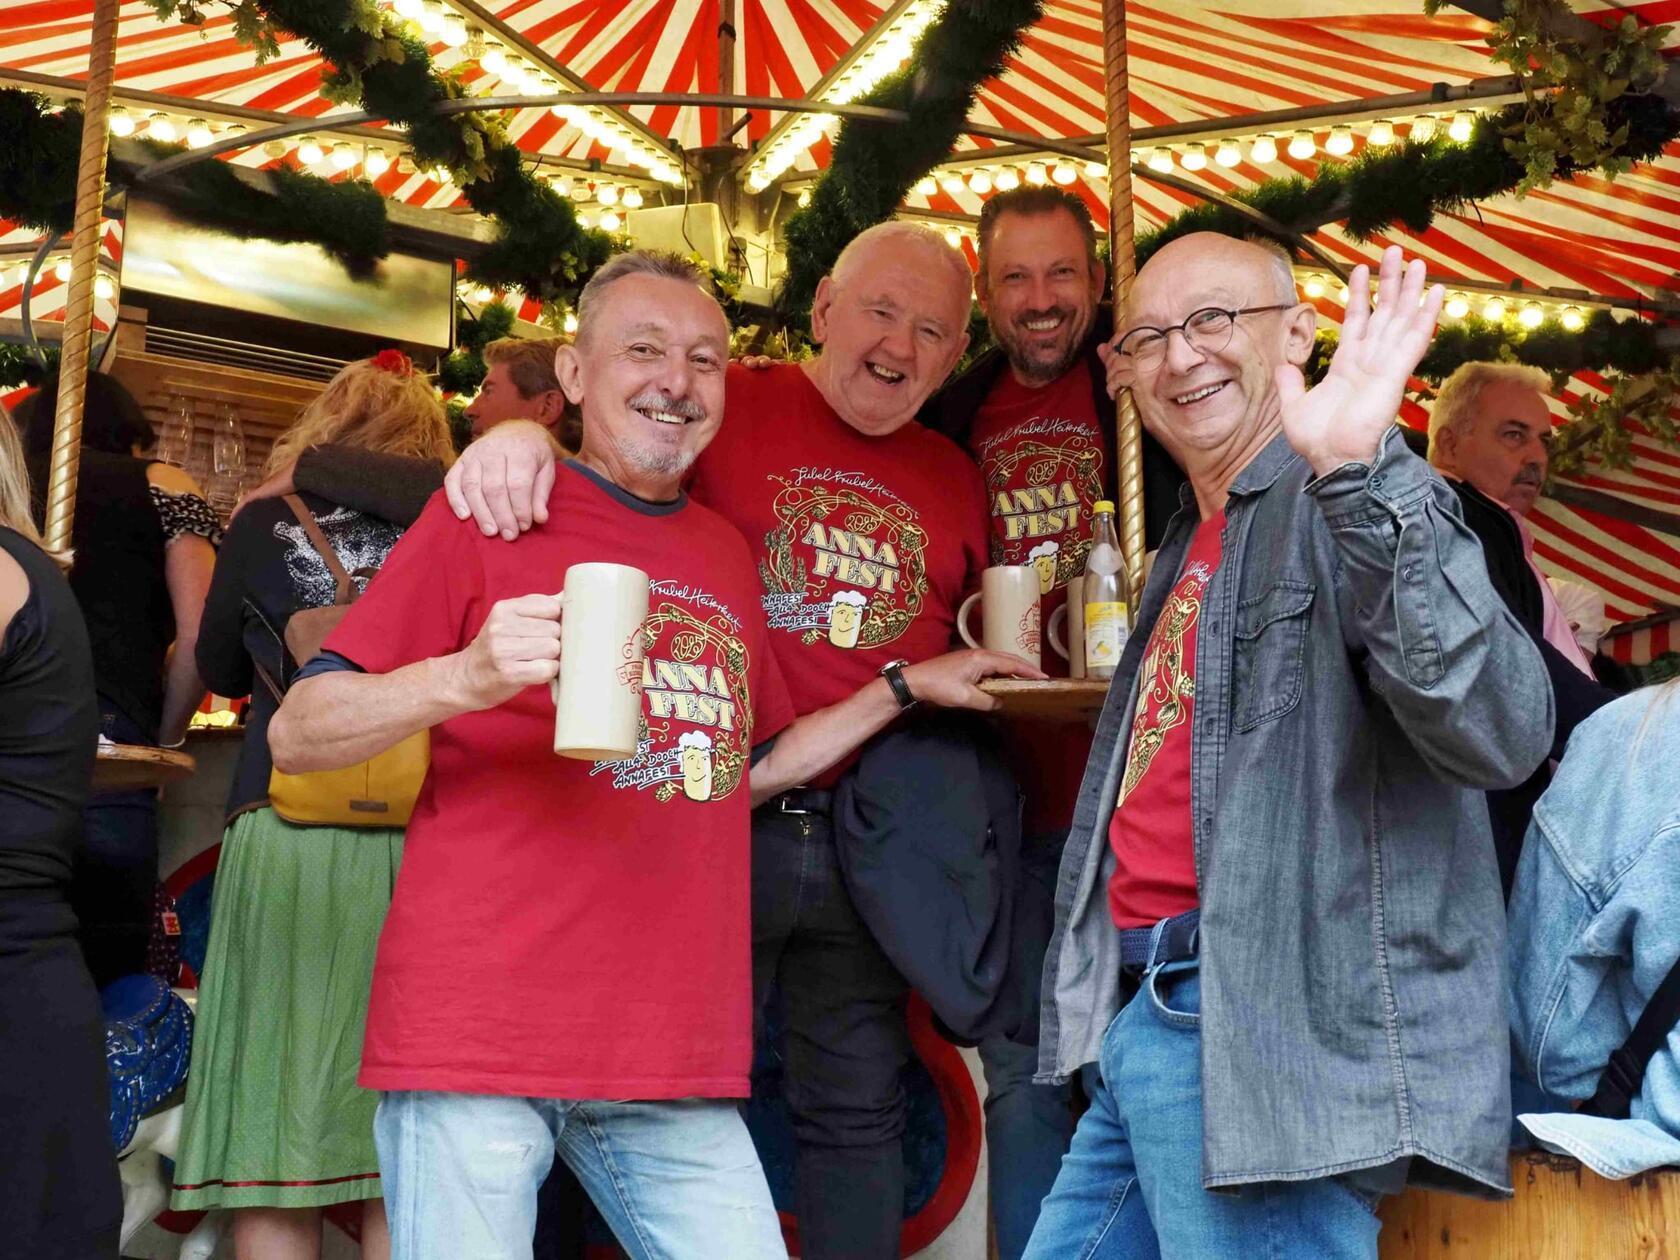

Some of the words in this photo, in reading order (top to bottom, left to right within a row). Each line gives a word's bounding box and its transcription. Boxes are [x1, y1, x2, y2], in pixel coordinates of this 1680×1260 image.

[1029, 461, 1057, 484] 2025
[992, 480, 1080, 516] ANNA
[847, 515, 878, 533] 2025
[1004, 504, 1081, 540] FEST
[802, 522, 899, 567] ANNA
[812, 549, 900, 594] FEST
[673, 635, 704, 659] 2025
[645, 690, 735, 731] FEST
[612, 756, 641, 773] ALLA
[648, 748, 681, 766] DOOCH
